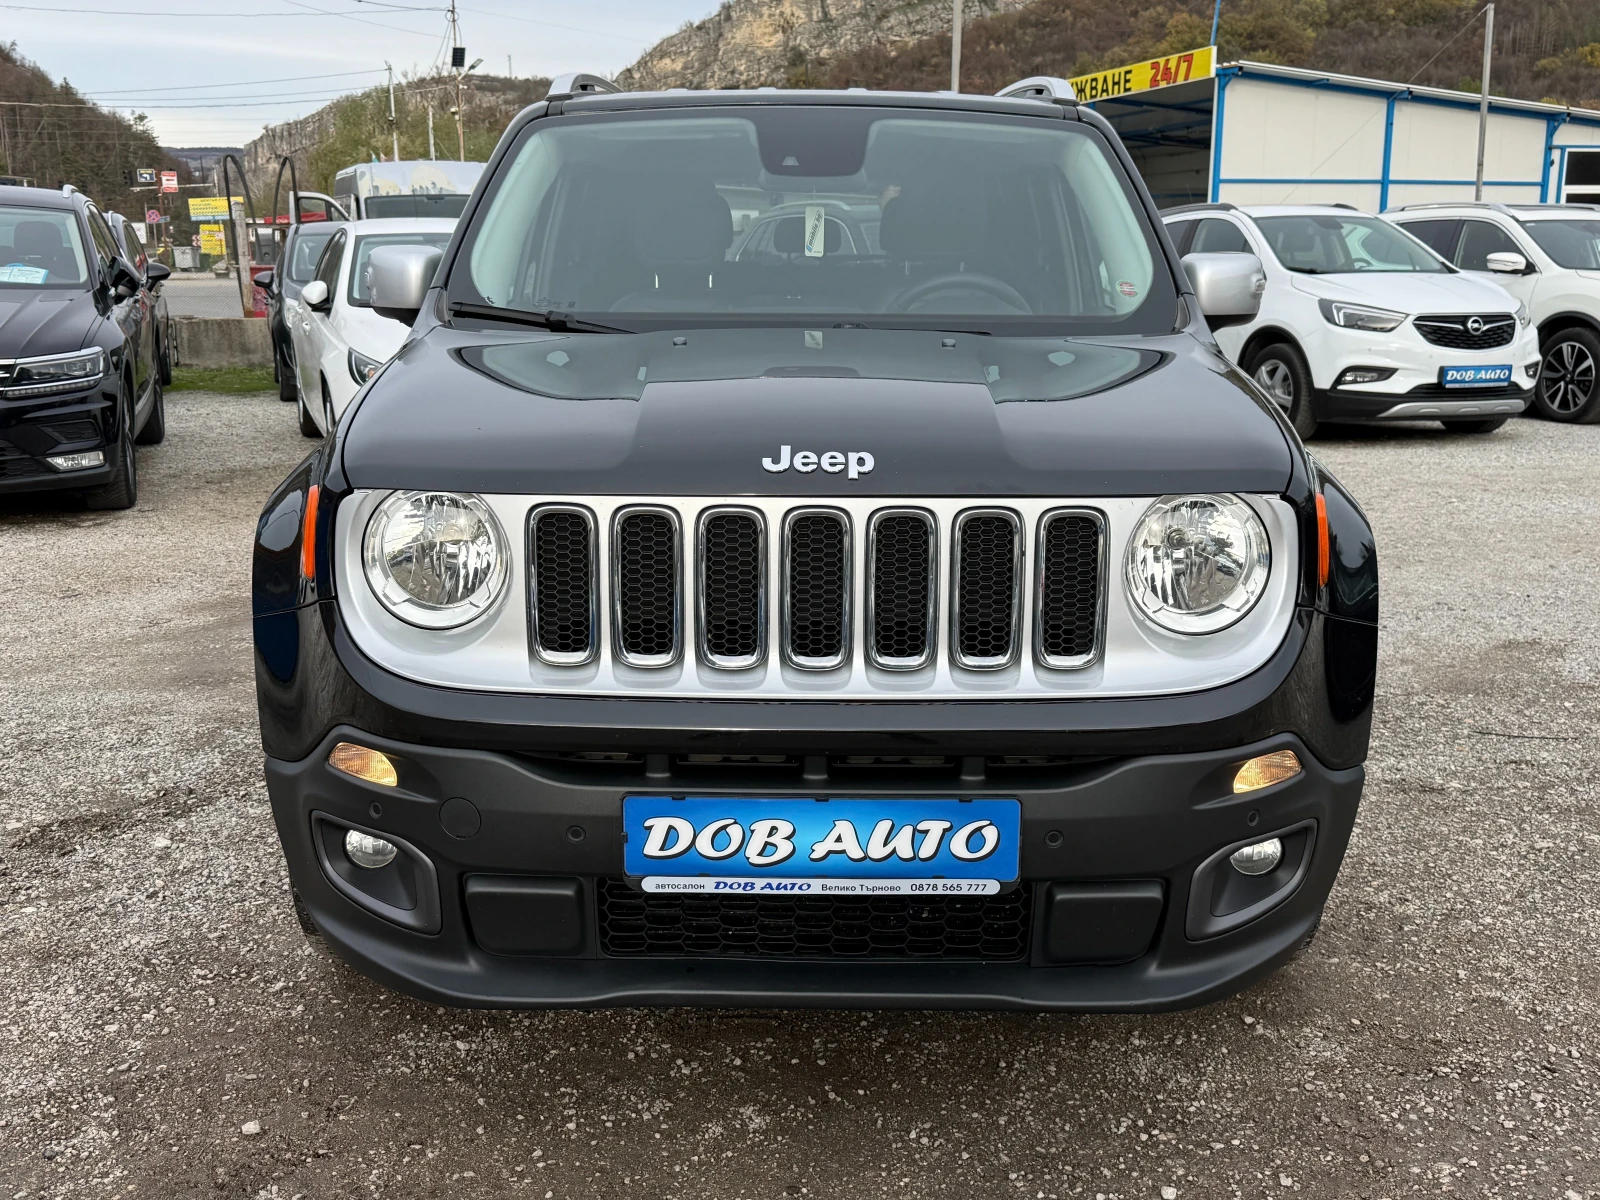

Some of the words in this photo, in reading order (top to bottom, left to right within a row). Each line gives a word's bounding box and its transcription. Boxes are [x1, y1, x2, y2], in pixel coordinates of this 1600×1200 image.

[1150, 53, 1194, 88] 24/7
[1446, 370, 1475, 381] DOB
[1477, 369, 1509, 380] AUTO
[761, 445, 875, 480] Jeep
[642, 816, 796, 867] DOB
[809, 819, 1000, 862] AUTO
[655, 882, 705, 890] автосалон
[714, 881, 756, 891] DOB
[760, 882, 811, 891] AUTO
[821, 883, 857, 892] Велико
[859, 884, 901, 893] Търново
[910, 883, 938, 892] 0878
[941, 883, 963, 892] 565
[966, 883, 987, 892] 777
